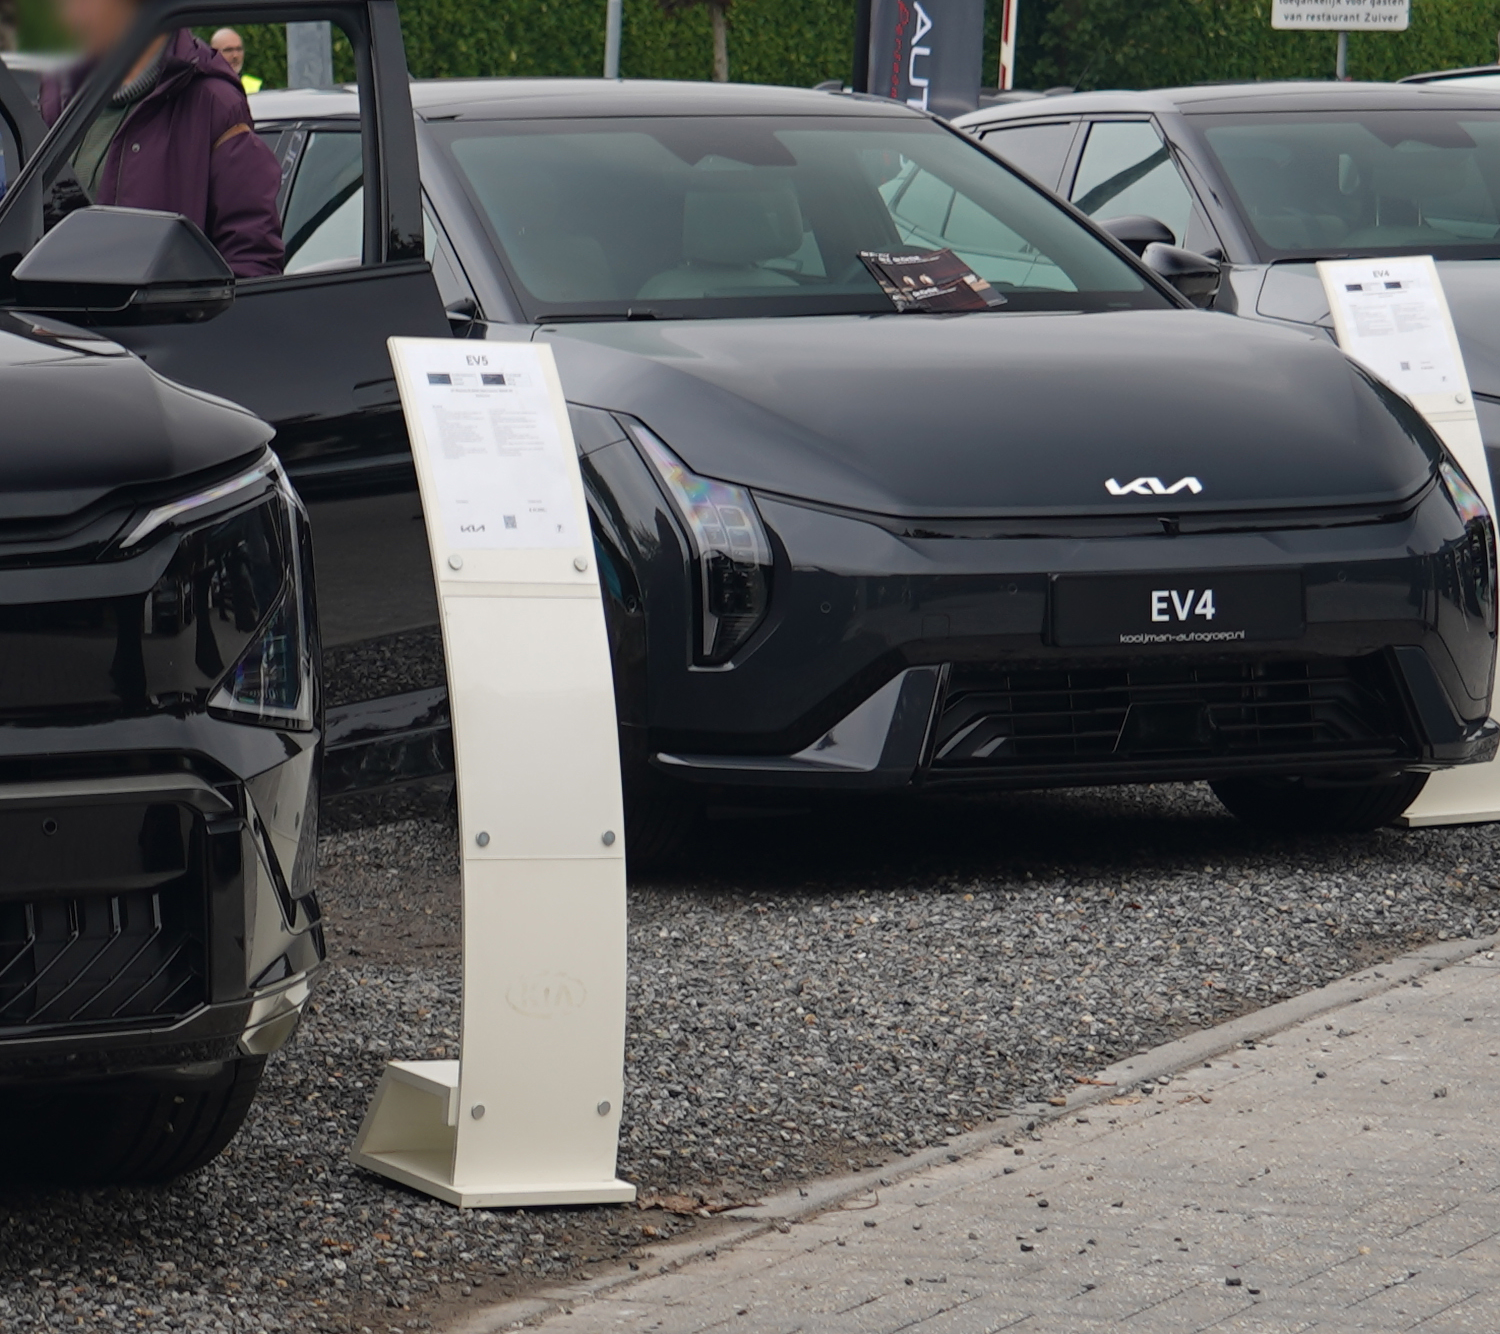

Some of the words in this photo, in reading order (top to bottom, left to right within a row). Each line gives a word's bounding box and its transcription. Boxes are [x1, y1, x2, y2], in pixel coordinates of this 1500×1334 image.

[1283, 13, 1302, 21] van
[1306, 13, 1360, 22] restaurant
[1364, 12, 1398, 22] Zuiver
[466, 355, 489, 366] EV5
[1105, 476, 1202, 495] KIA
[460, 524, 485, 533] KIA
[1151, 589, 1216, 622] EV4
[1119, 630, 1245, 644] kooijman-autogroep.nl
